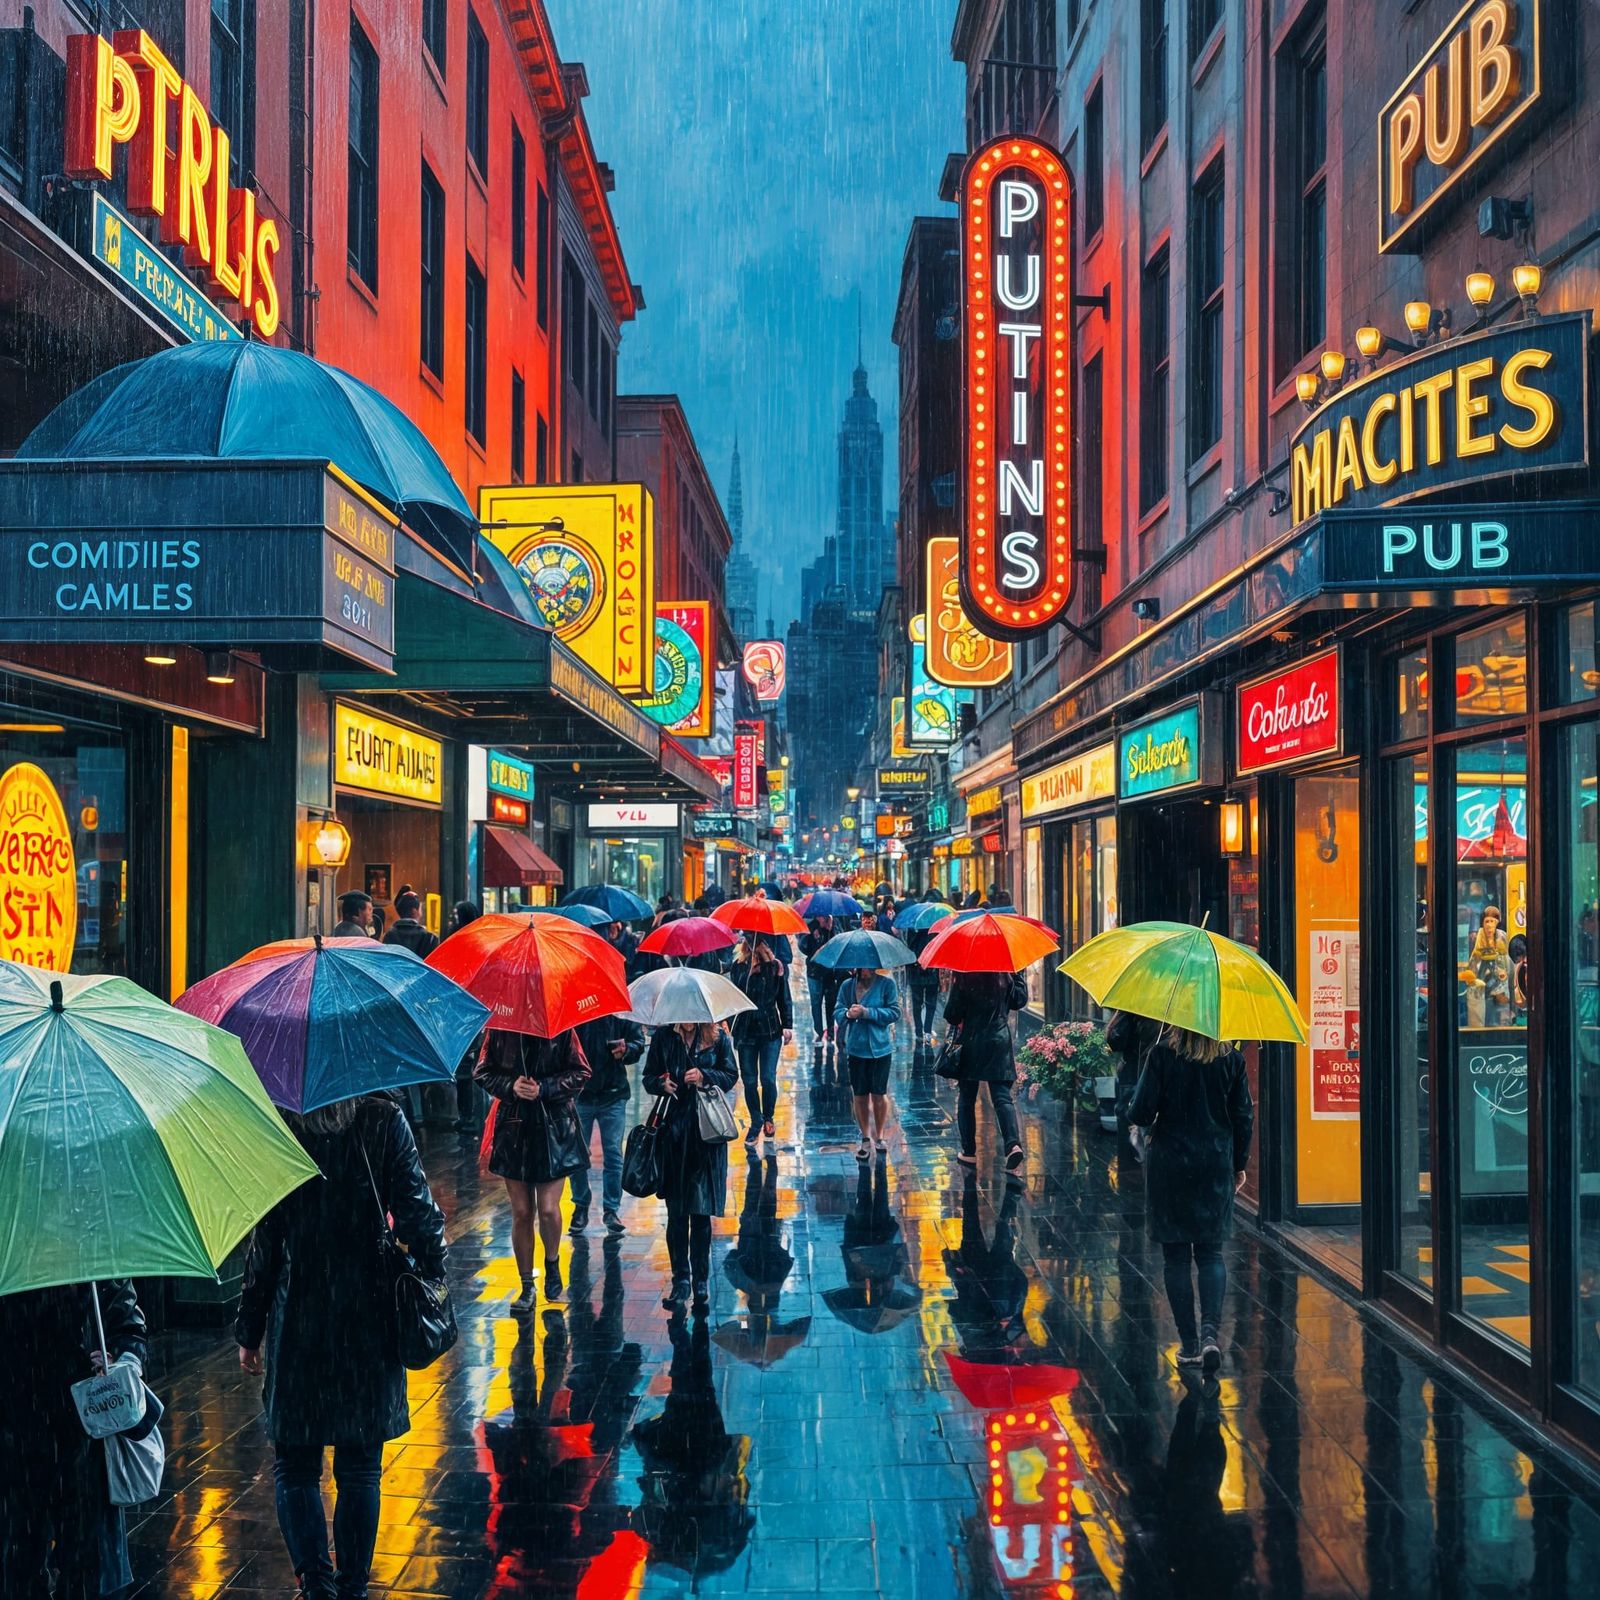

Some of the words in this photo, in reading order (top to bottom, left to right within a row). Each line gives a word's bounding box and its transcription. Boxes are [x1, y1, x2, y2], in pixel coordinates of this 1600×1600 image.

[1389, 0, 1513, 214] PUB
[996, 180, 1044, 590] PUTINS
[1292, 348, 1557, 525] MACITES
[56, 583, 193, 611] CAMLES
[1381, 521, 1510, 574] PUB
